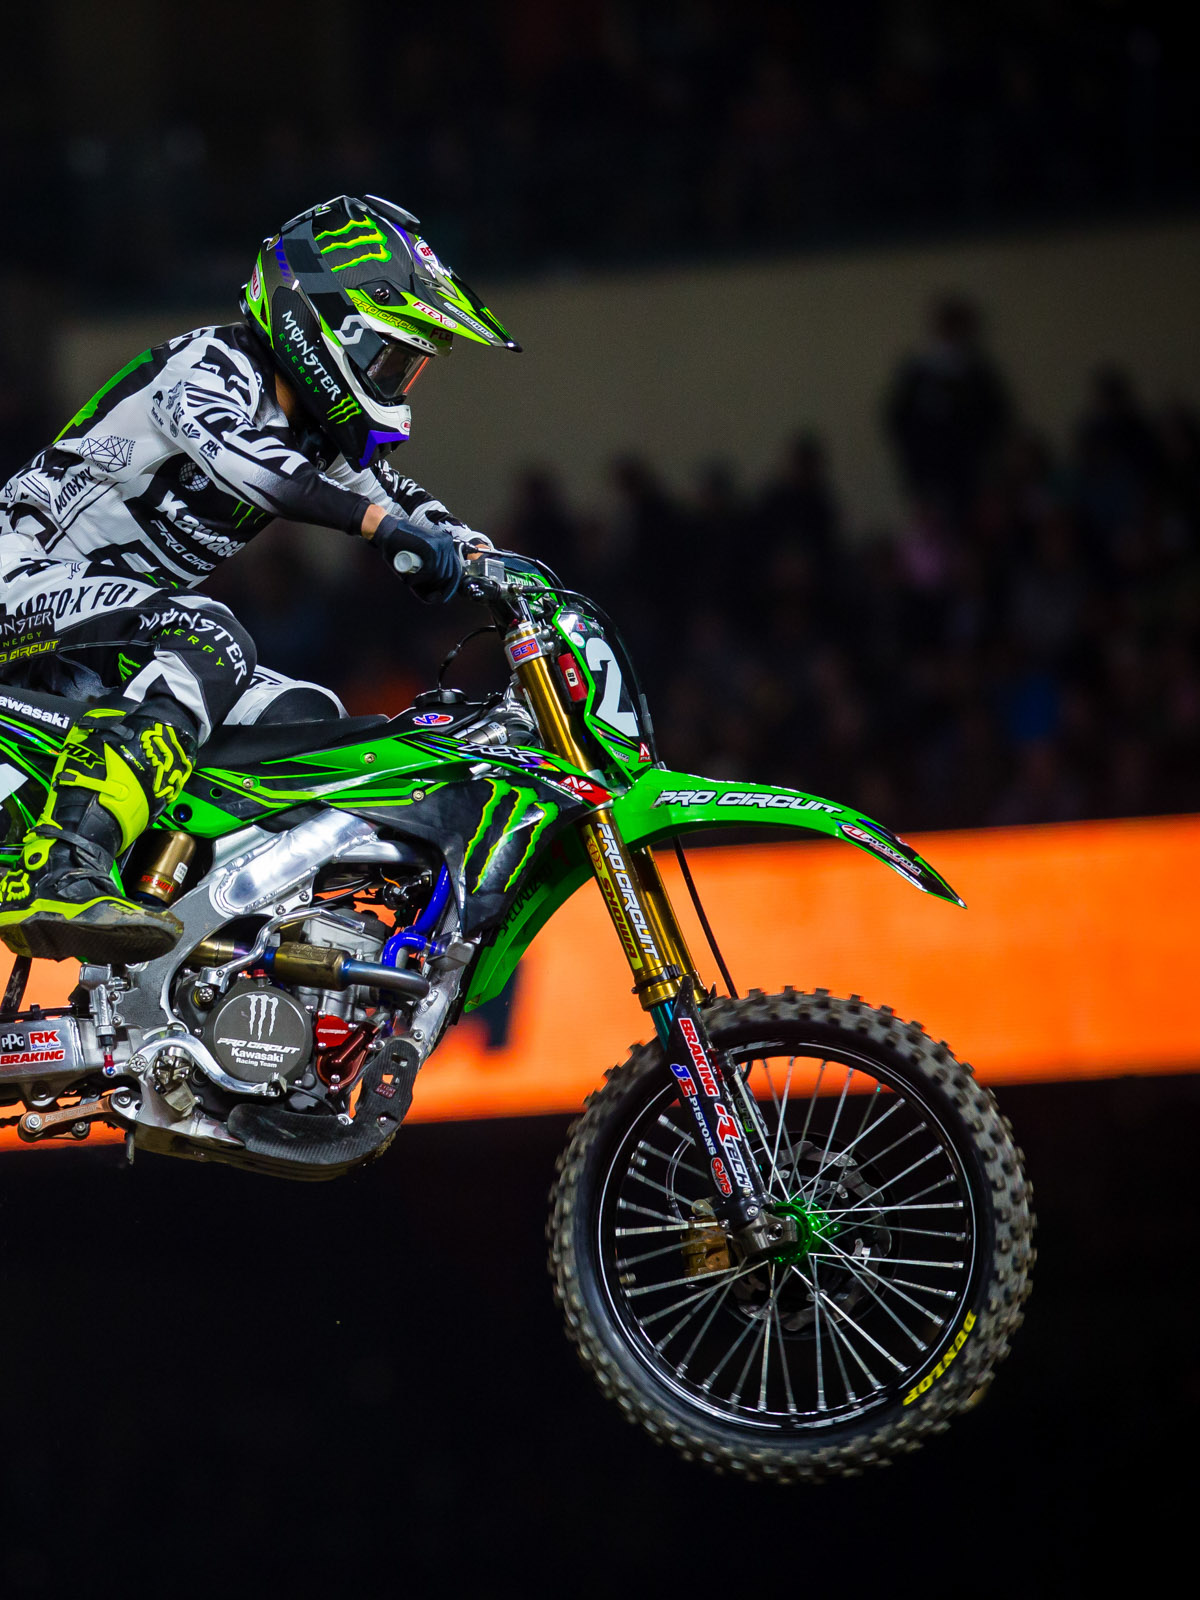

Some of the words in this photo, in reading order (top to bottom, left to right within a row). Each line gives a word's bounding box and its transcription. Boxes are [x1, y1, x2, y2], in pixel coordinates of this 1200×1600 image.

[278, 332, 320, 393] ENERGY
[9, 640, 59, 661] CIRCUIT
[511, 642, 536, 658] GET
[585, 637, 640, 737] 2
[654, 790, 718, 808] PRO
[716, 792, 845, 814] CIRCUIT
[596, 822, 626, 872] PRO
[614, 872, 660, 961] CIRCUIT
[601, 876, 638, 959] SHOWA
[29, 1030, 60, 1045] RK
[217, 1037, 248, 1047] PRO
[246, 1041, 301, 1054] CIRCUIT
[231, 1047, 284, 1063] Kawasaki
[0, 1050, 65, 1065] BRAKING
[235, 1057, 259, 1067] Racing
[259, 1060, 278, 1068] Team
[678, 1017, 721, 1097] BRAKING
[670, 1063, 699, 1098] JE
[689, 1095, 718, 1156] PISTONS
[712, 1157, 733, 1195] GUTS
[902, 1309, 977, 1406] DUNLOP
